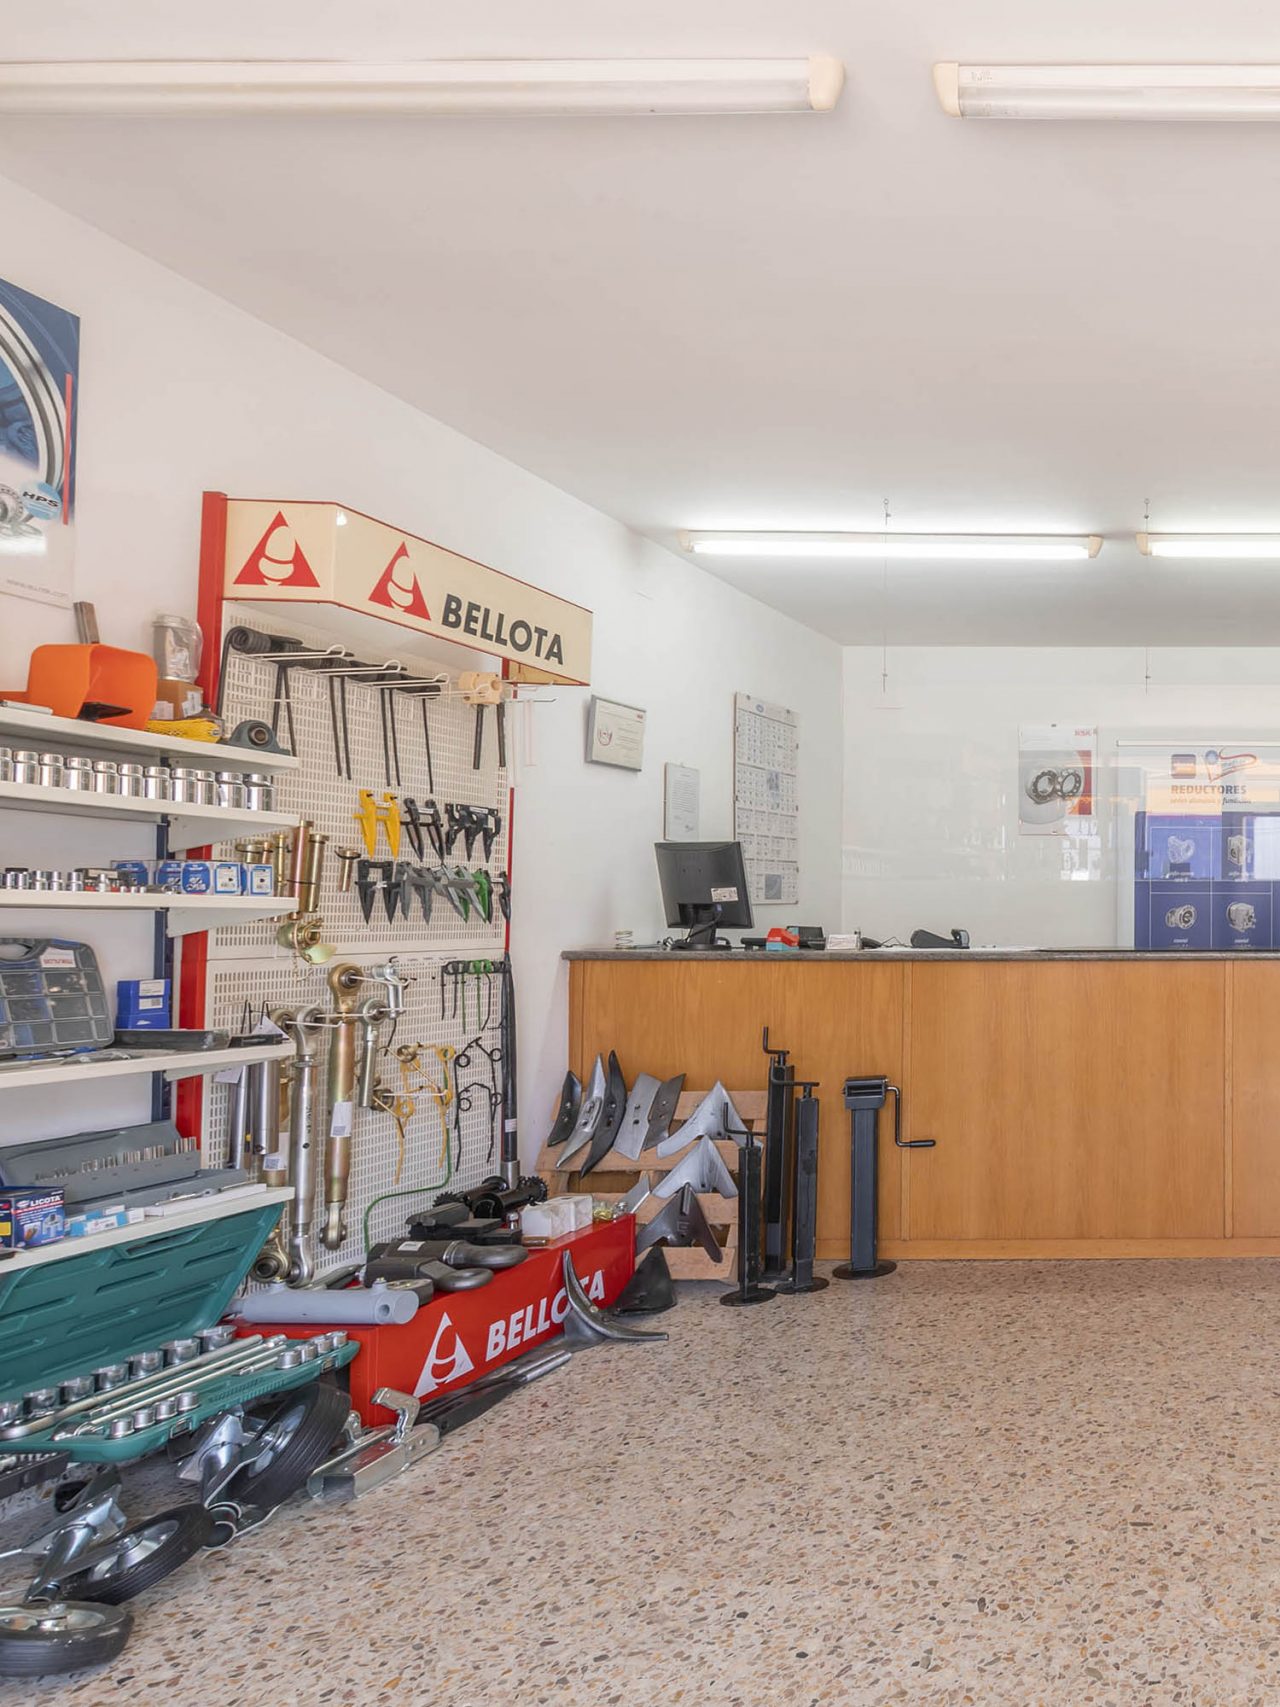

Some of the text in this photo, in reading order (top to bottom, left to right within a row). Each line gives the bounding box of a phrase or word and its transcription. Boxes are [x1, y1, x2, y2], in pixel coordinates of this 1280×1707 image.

[22, 491, 58, 508] HPS
[441, 593, 564, 665] BELLOTA
[1170, 784, 1247, 795] REDUCTORES
[30, 1195, 62, 1207] LICOTA
